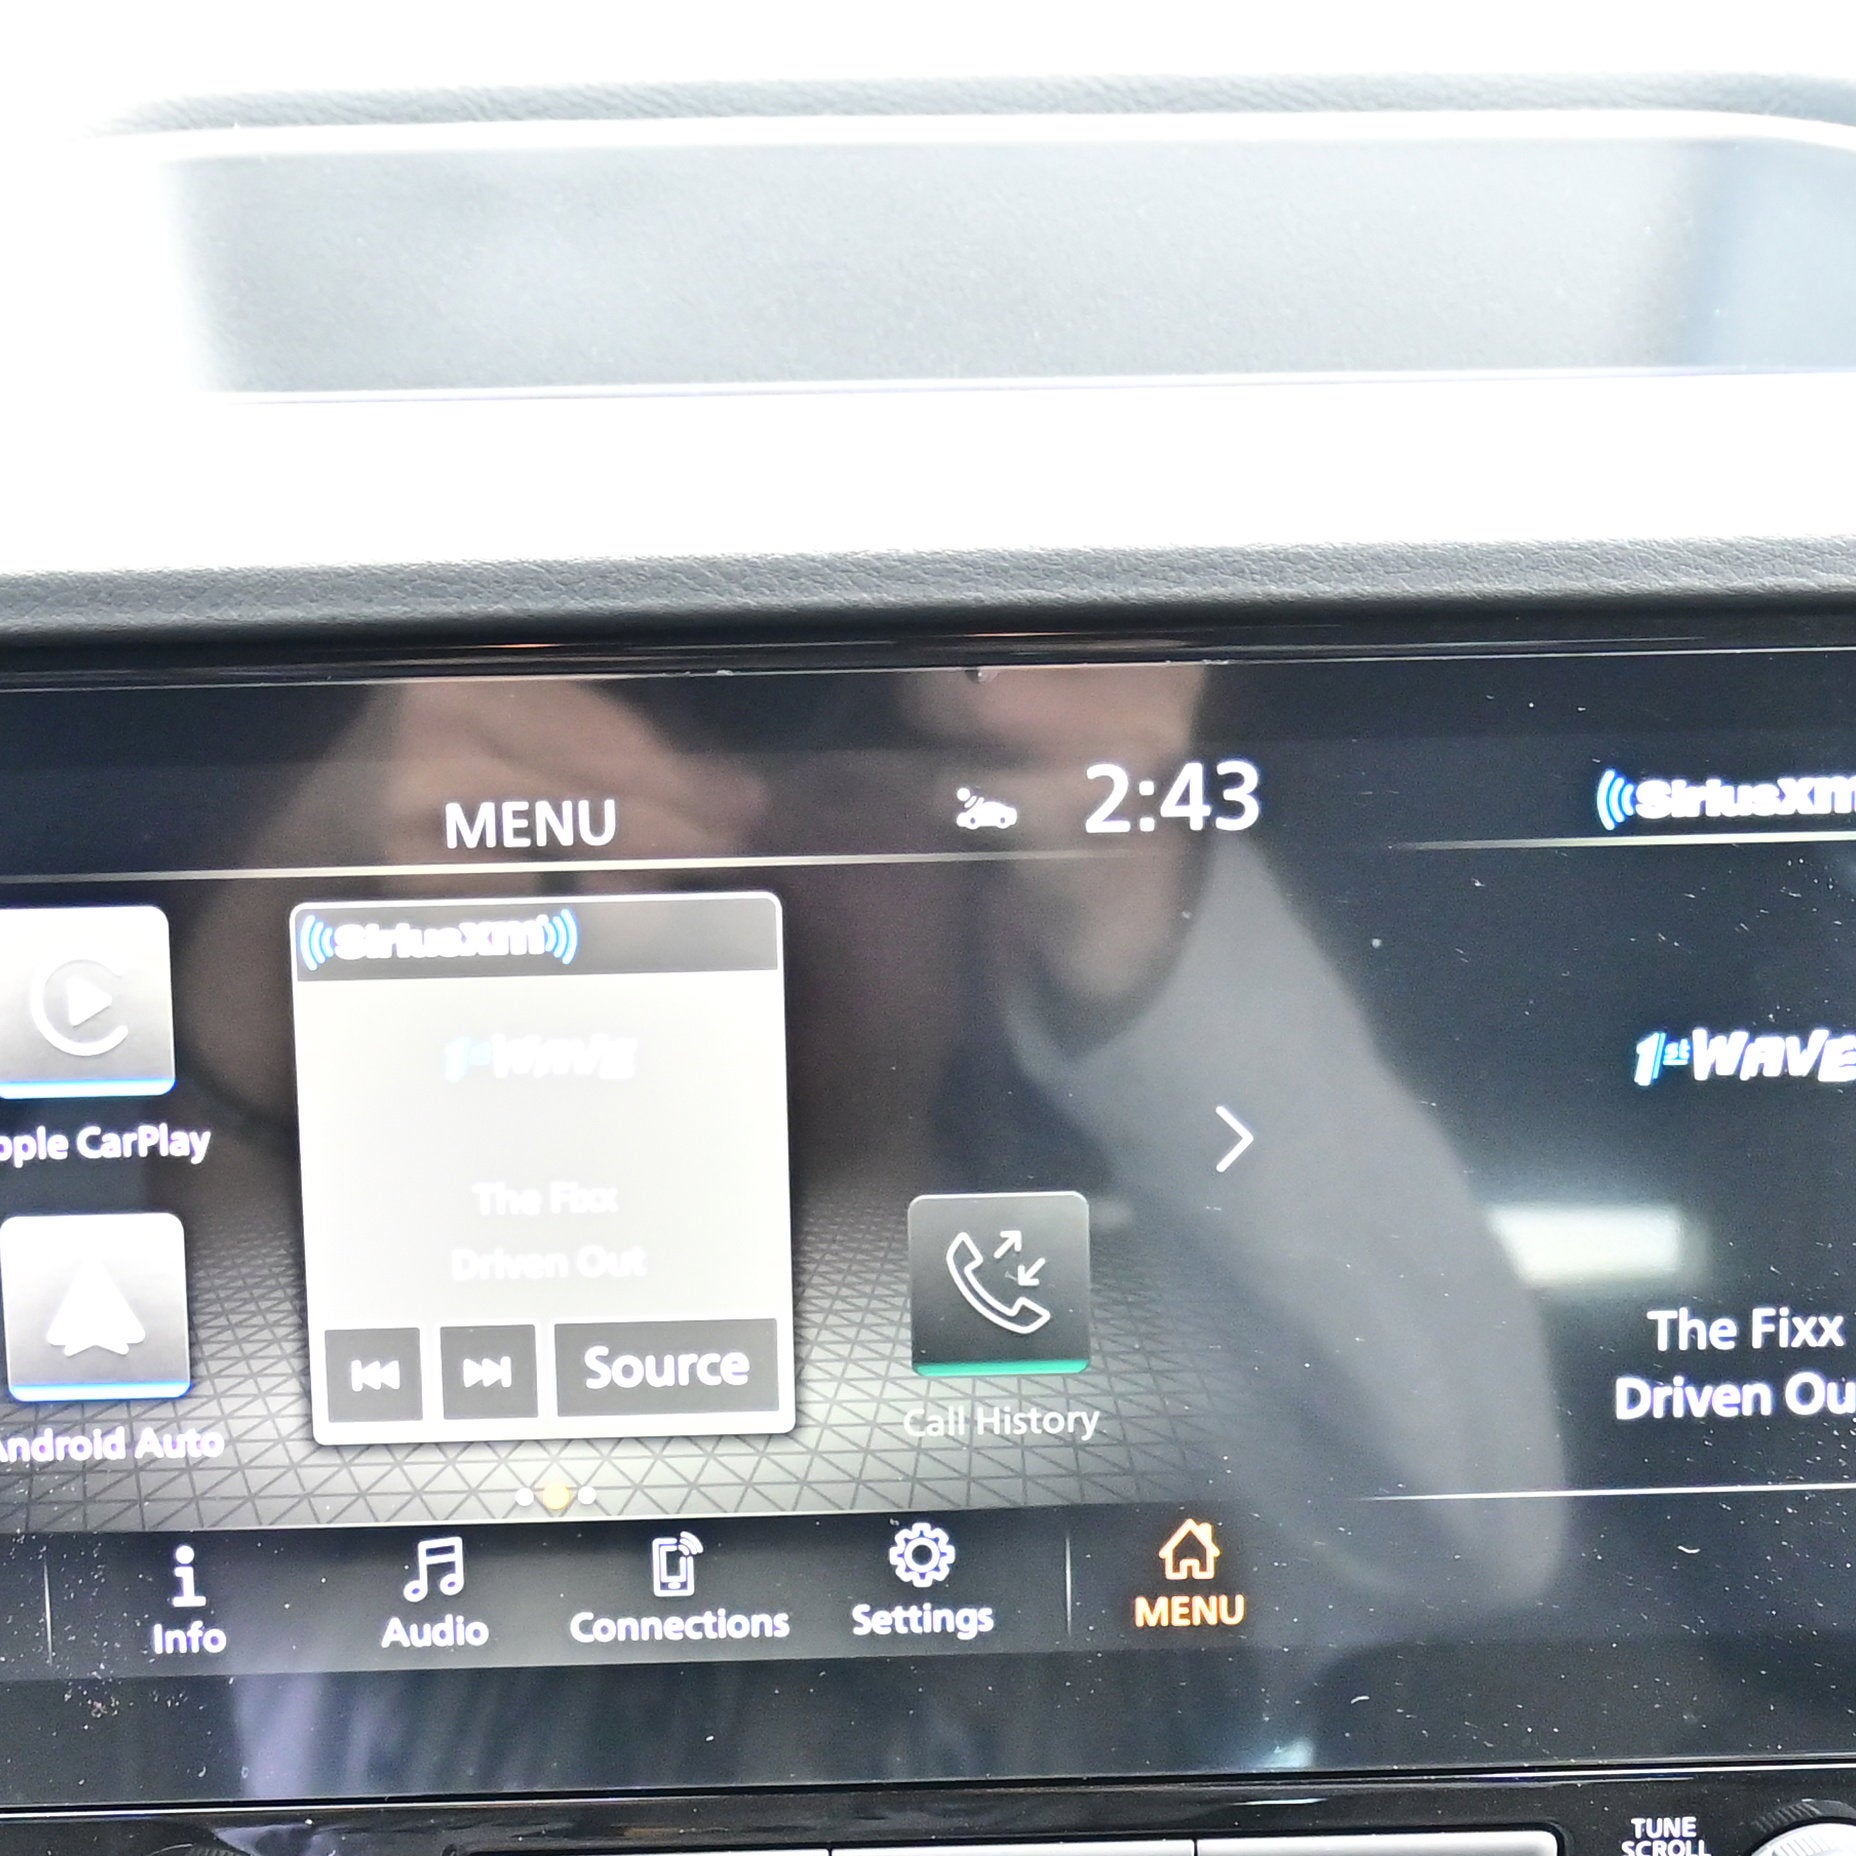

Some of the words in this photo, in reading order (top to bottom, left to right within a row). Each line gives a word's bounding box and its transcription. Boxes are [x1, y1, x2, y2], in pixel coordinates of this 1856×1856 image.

[1084, 758, 1261, 833] 2:43
[444, 799, 617, 849] MENU
[76, 1123, 211, 1164] CarPlay
[577, 1244, 648, 1277] Out
[1648, 1308, 1736, 1352] The
[1751, 1307, 1846, 1349] Fixx
[584, 1345, 749, 1390] Source
[1613, 1374, 1773, 1422] Driven
[903, 1407, 966, 1439] Call
[975, 1406, 1100, 1443] History
[133, 1427, 226, 1461] Auto
[569, 1609, 791, 1644] Connections
[851, 1602, 995, 1641] Settings
[1133, 1594, 1246, 1628] MENU
[152, 1622, 227, 1655] Info
[380, 1613, 490, 1650] Audio
[1630, 1817, 1696, 1840] TUNE
